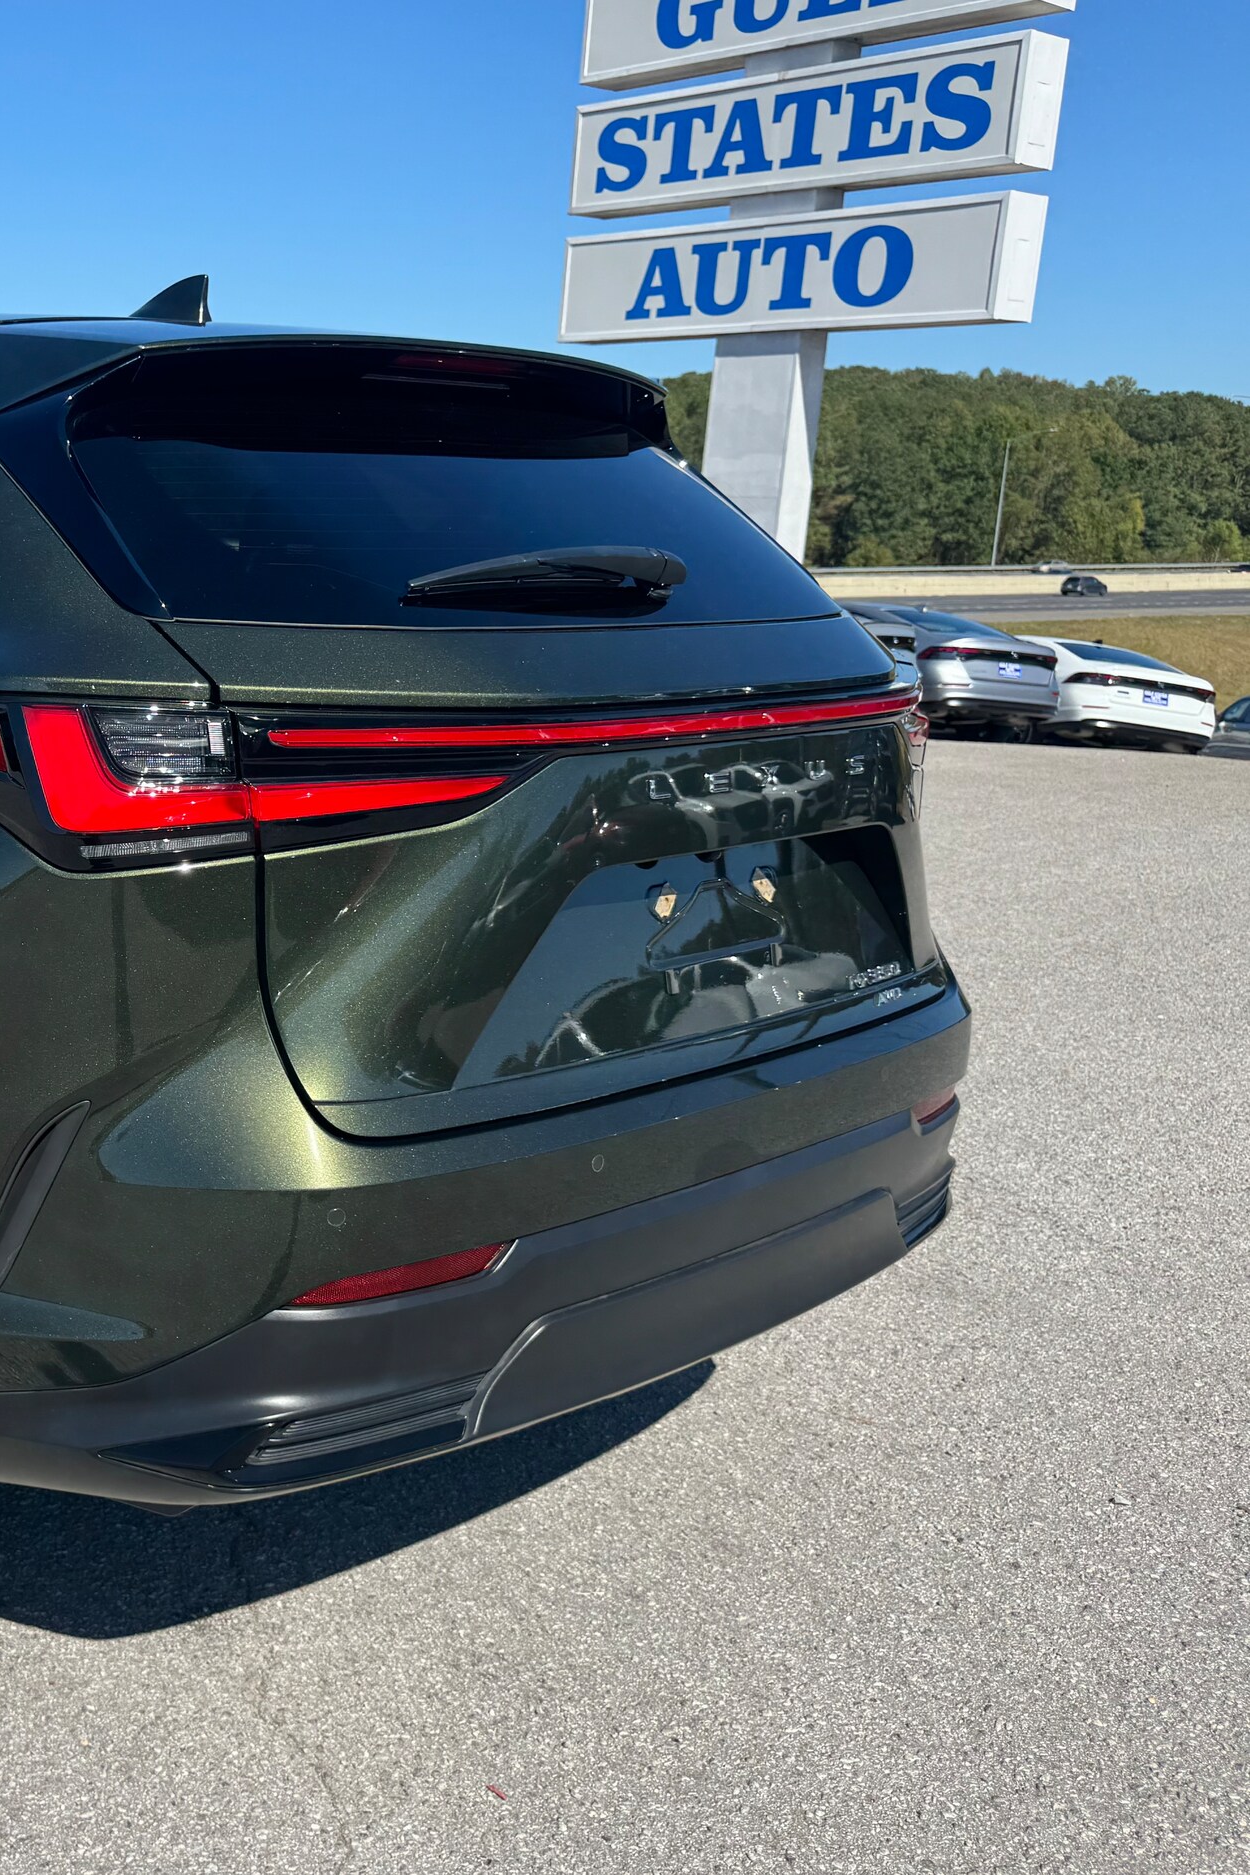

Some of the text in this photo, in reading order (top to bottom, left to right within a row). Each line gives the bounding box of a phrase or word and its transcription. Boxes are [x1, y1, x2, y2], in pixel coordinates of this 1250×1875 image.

[596, 61, 995, 193] STATES
[626, 225, 913, 320] AUTO
[646, 755, 865, 799] LEXUS
